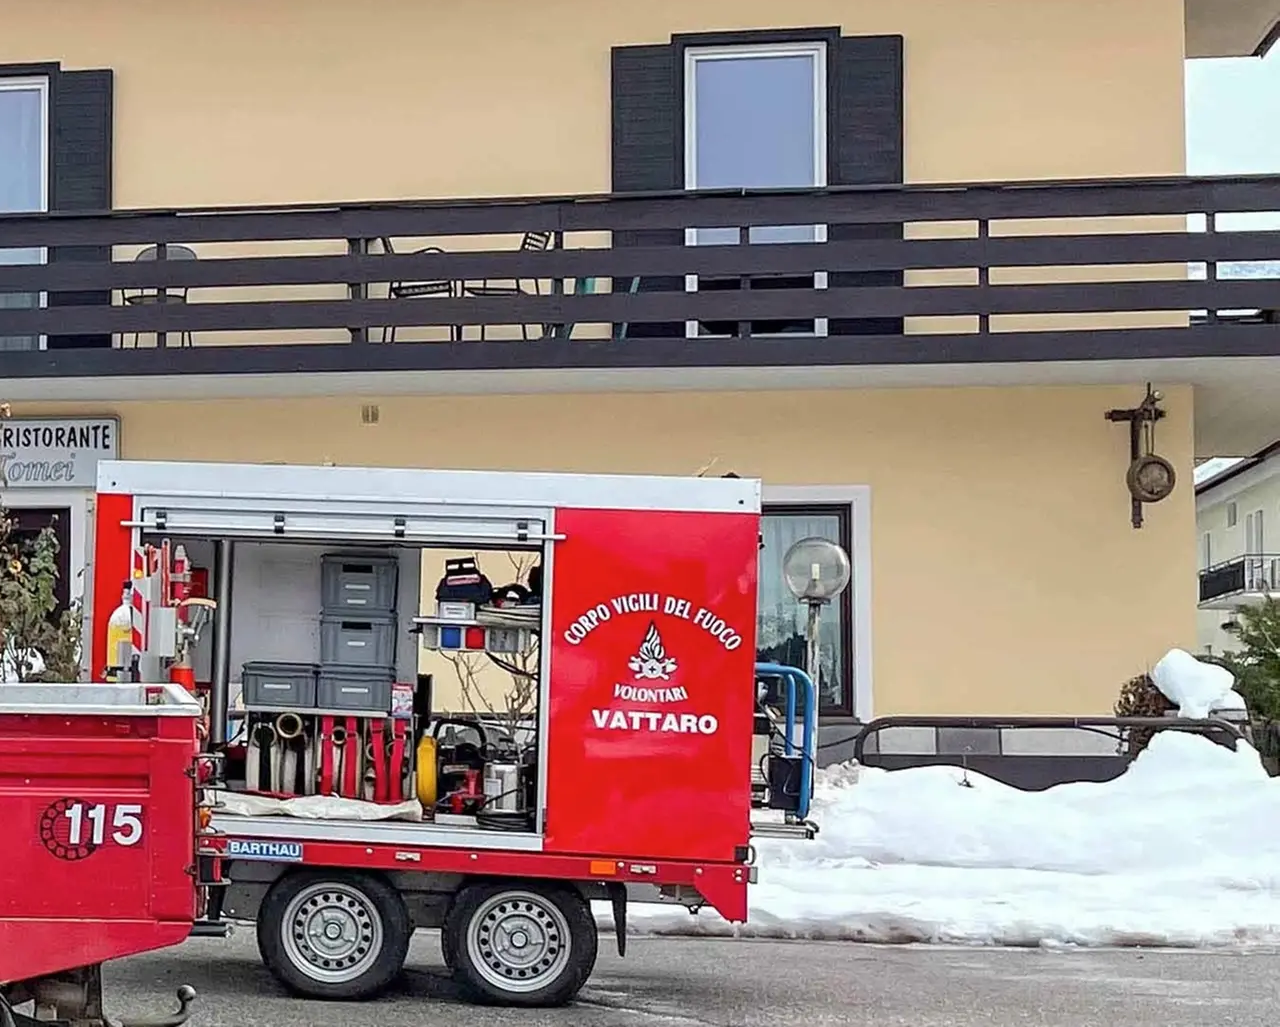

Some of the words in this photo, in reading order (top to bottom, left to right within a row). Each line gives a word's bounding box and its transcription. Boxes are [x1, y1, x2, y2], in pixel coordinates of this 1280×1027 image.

[3, 424, 111, 450] RISTORANTE
[563, 603, 611, 645] CORPO
[611, 593, 659, 615] VIGILI
[663, 596, 692, 620] DEL
[693, 608, 743, 651] FUOCO
[614, 683, 688, 703] VOLONTARI
[591, 709, 719, 735] VATTARO
[65, 803, 143, 847] 115
[230, 840, 301, 857] BARTHAU
